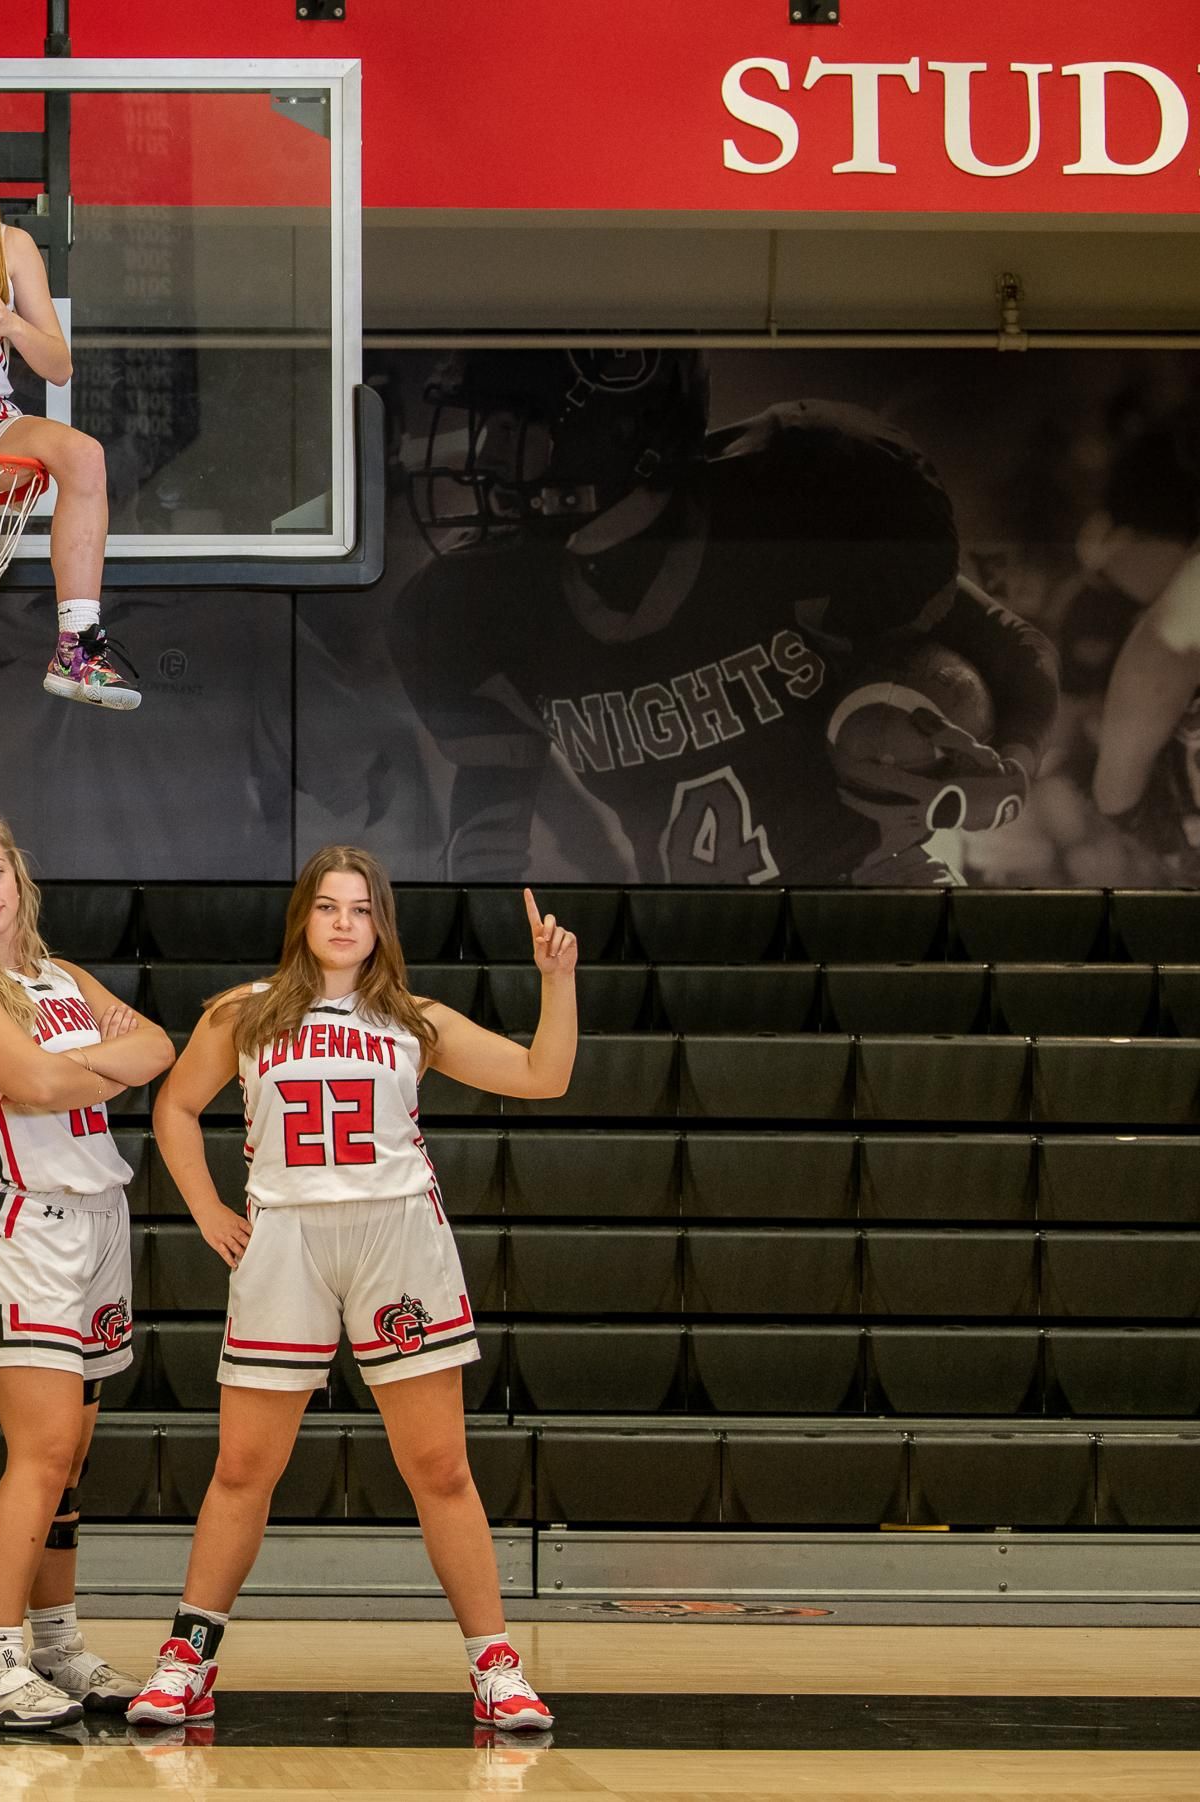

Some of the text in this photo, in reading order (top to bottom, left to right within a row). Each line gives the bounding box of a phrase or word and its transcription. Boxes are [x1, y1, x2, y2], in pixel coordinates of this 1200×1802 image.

[721, 56, 1200, 177] STUD
[538, 630, 825, 773] NIGHTS
[274, 1078, 377, 1168] 22
